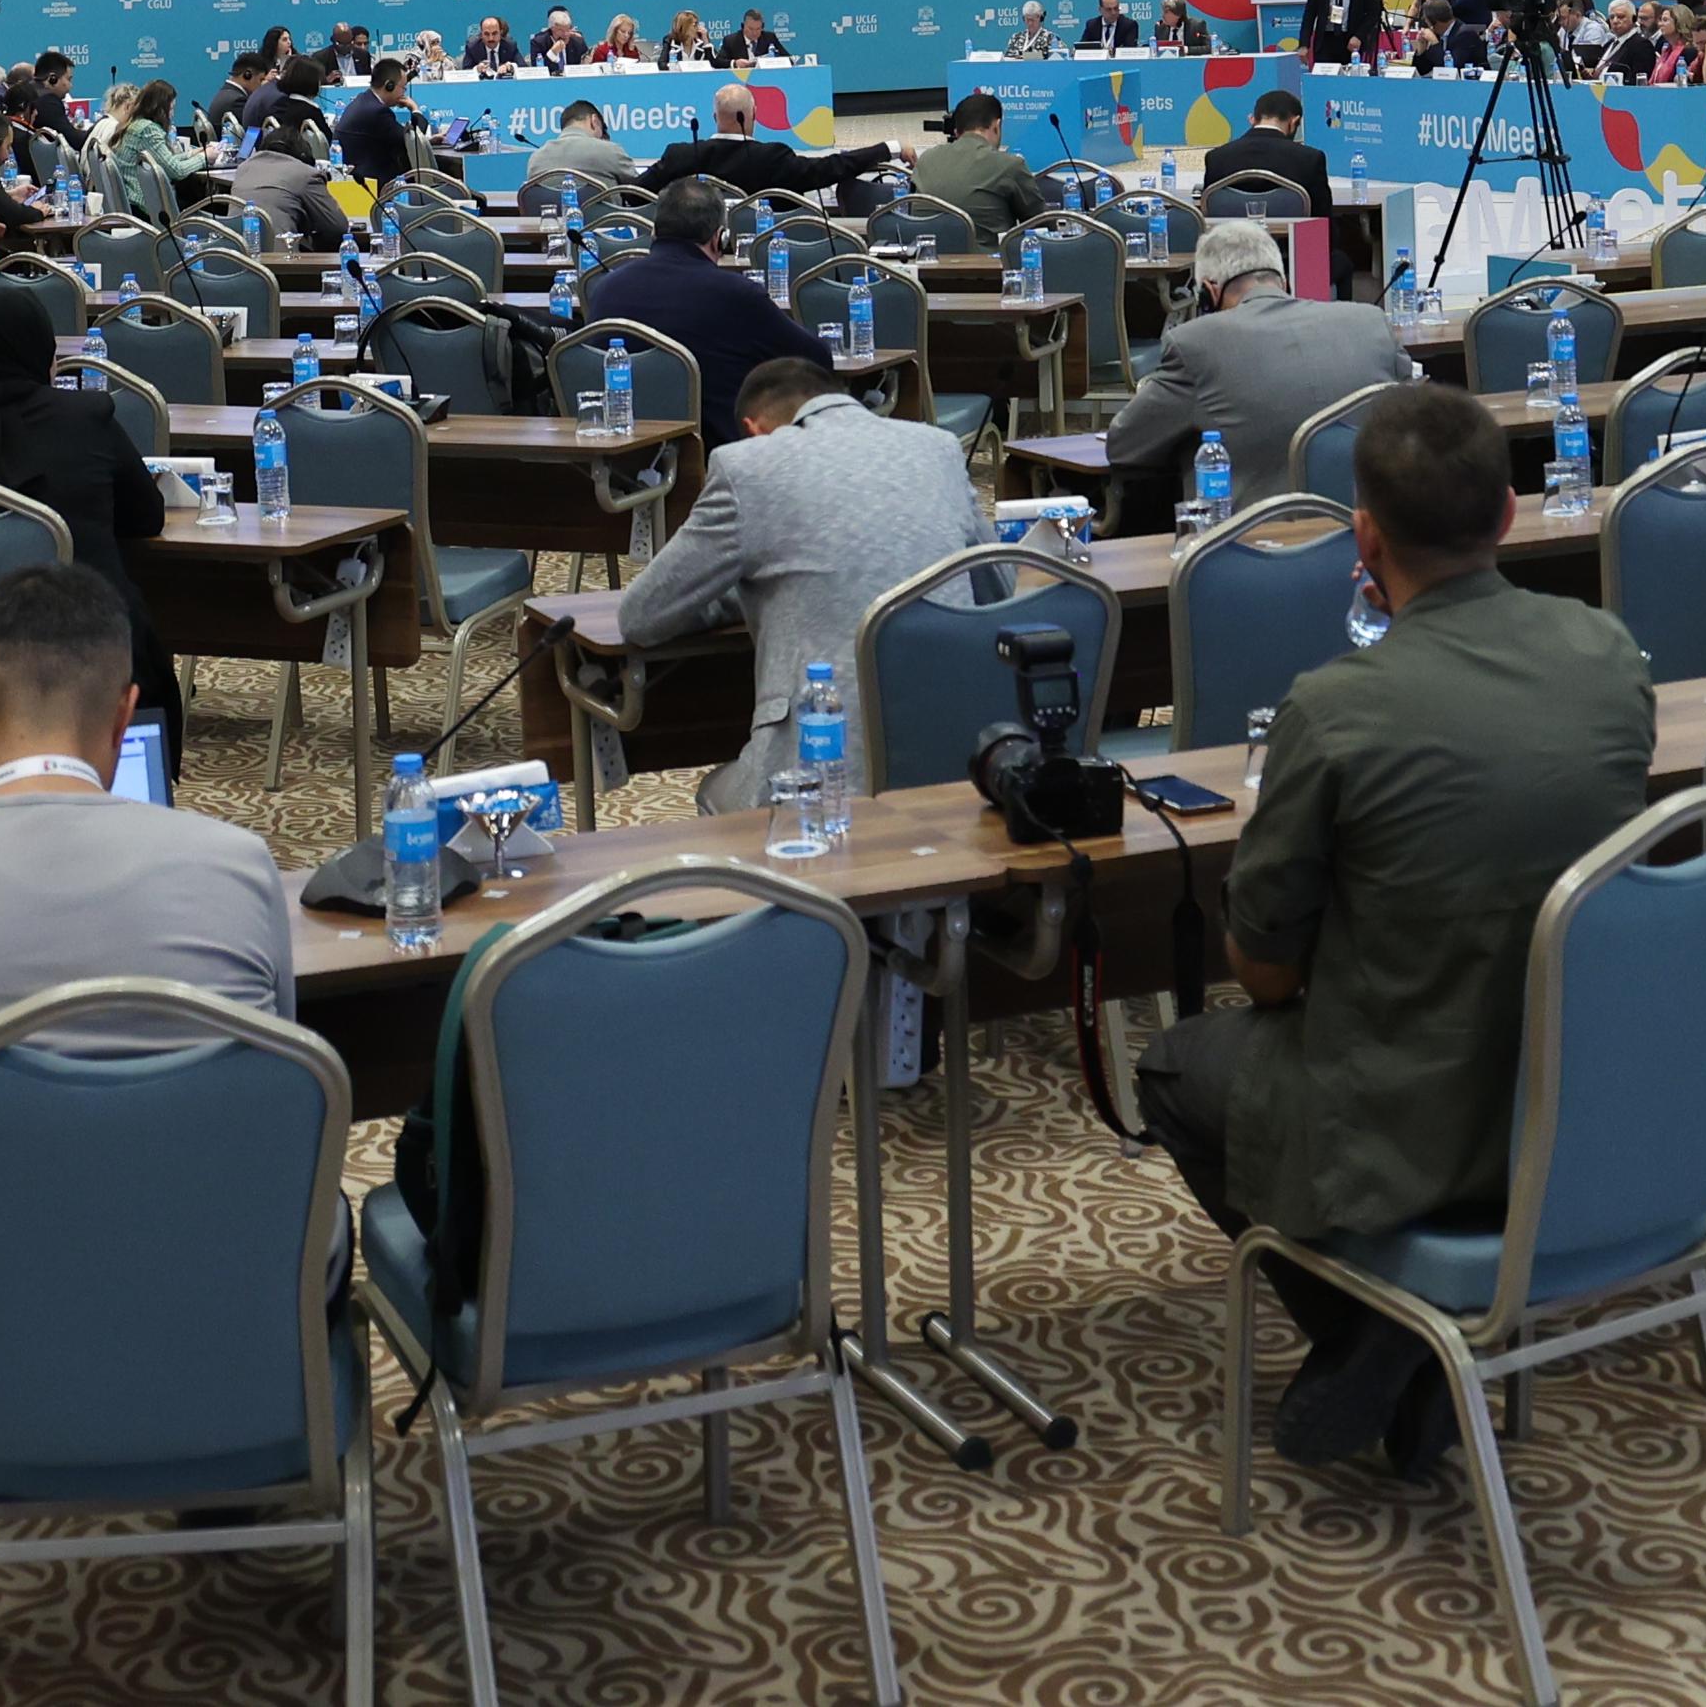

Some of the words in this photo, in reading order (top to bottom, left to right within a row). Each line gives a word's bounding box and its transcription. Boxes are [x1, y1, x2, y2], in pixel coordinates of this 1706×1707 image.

[146, 0, 172, 10] CGLU
[1131, 1, 1152, 11] UCLG
[997, 7, 1019, 17] UCLG
[1131, 12, 1152, 21] CGLU
[855, 14, 878, 24] UCLG
[997, 18, 1019, 27] CGLU
[708, 20, 731, 29] UCLG
[855, 25, 878, 34] CGLU
[234, 40, 258, 49] UCLG
[64, 45, 89, 55] UCLG
[67, 55, 89, 65] GLU
[997, 85, 1030, 98] UCLG
[1343, 100, 1365, 116] UCLG
[508, 102, 696, 136] #UCMeets
